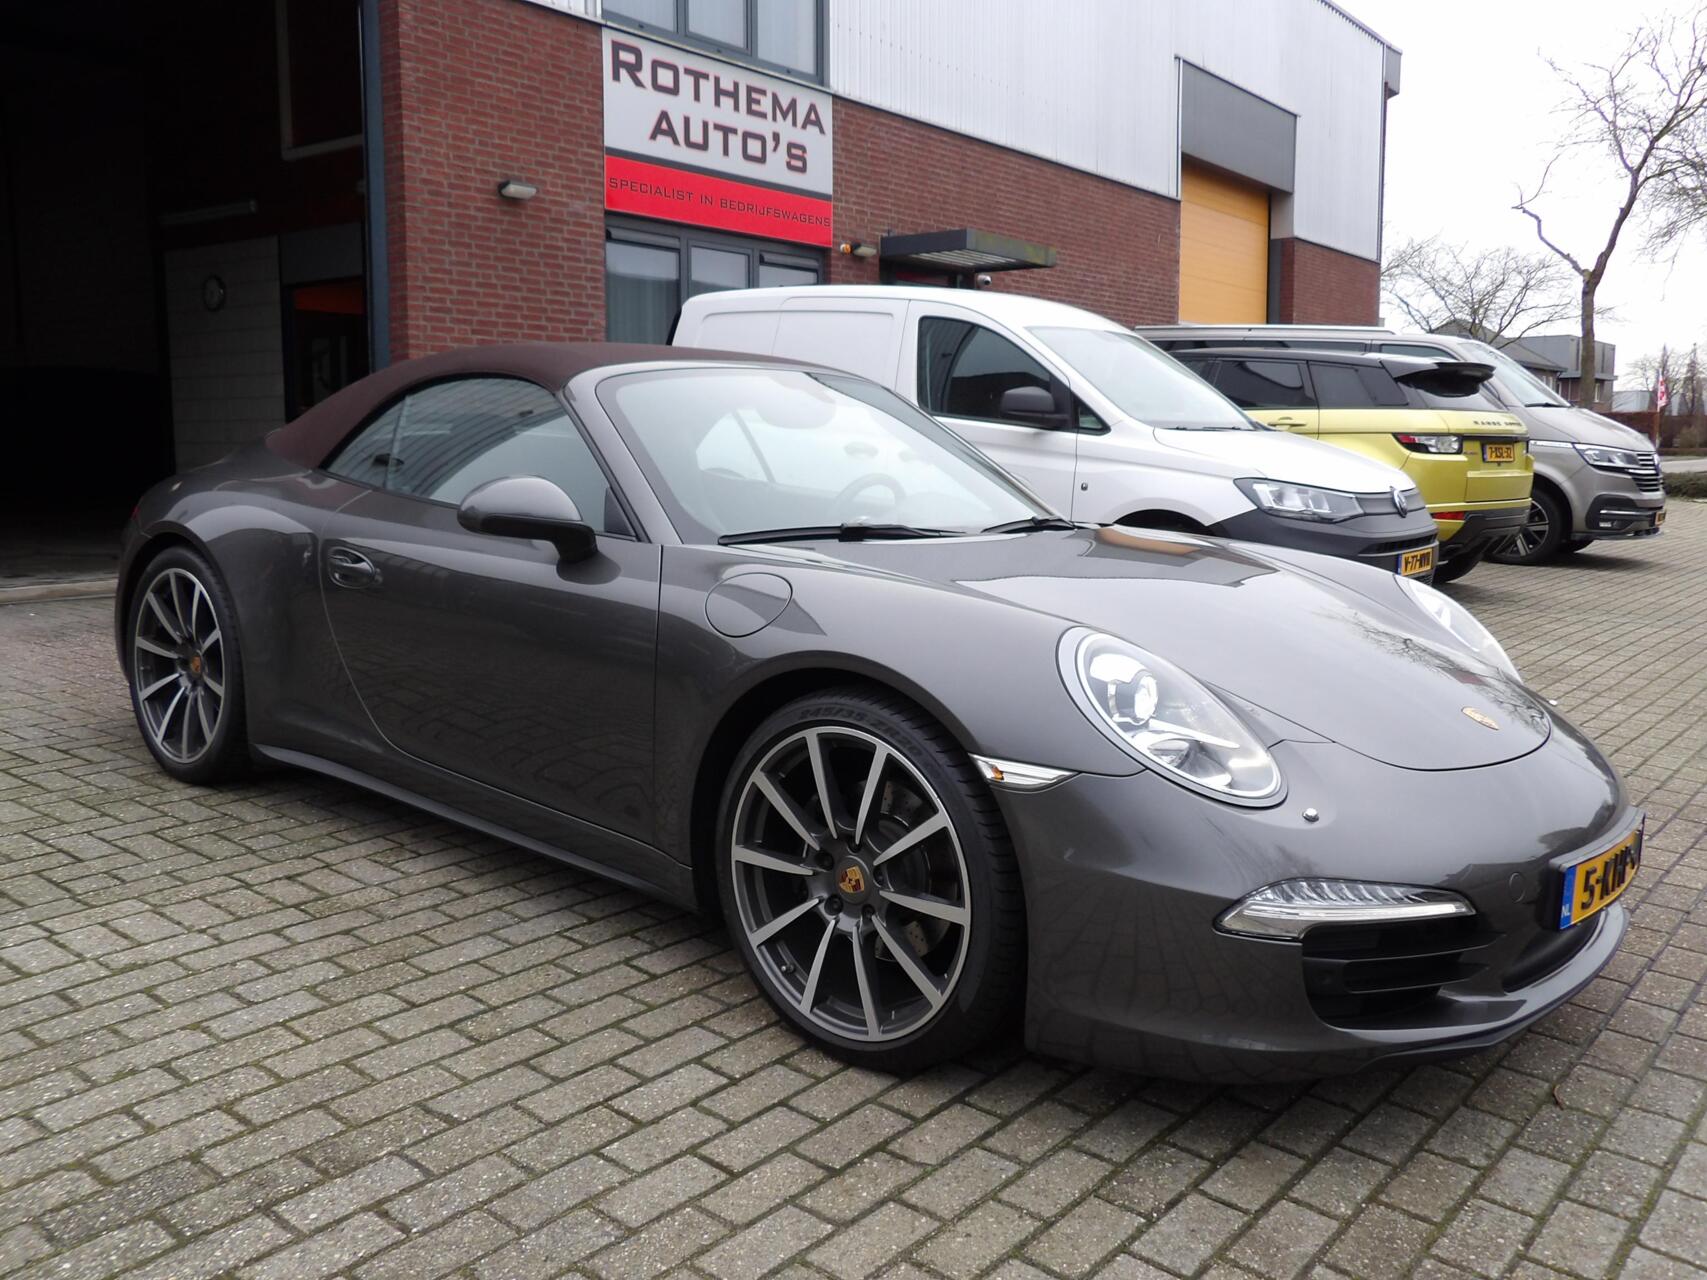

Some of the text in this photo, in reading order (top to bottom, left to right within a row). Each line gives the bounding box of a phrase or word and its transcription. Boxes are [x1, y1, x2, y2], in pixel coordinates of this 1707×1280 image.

[611, 39, 826, 135] ROTHEMA
[649, 109, 808, 174] AUTO'S
[609, 176, 831, 227] SPECIALIST IN BEDRIJFSWAGENS
[1561, 903, 1571, 918] NL
